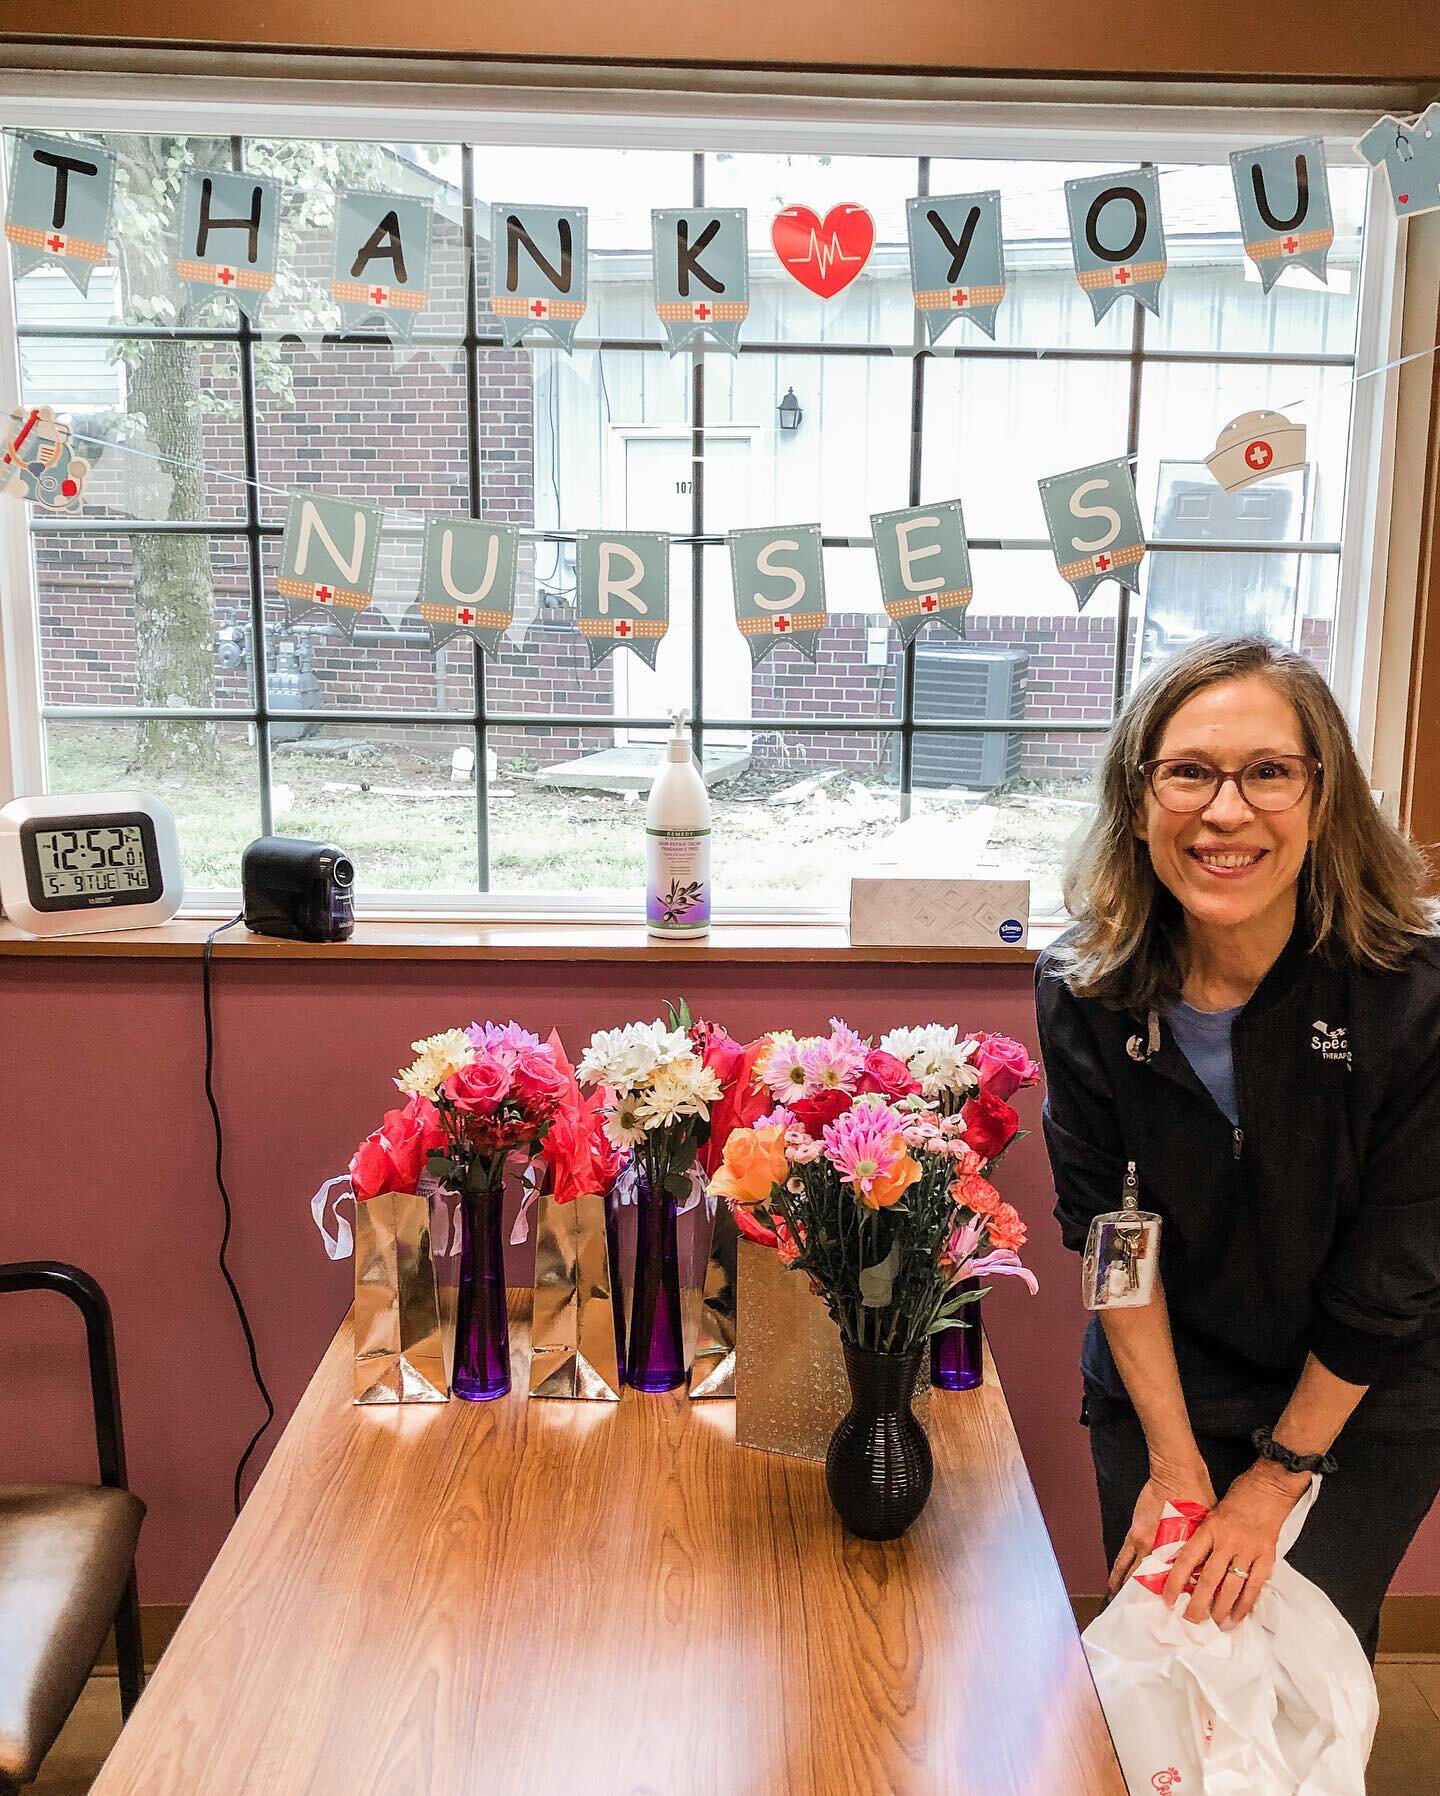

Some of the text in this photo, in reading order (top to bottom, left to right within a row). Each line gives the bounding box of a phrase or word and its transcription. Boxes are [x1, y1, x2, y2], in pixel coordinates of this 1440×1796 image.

[32, 149, 1309, 297] THANK YOU
[676, 481, 692, 494] 107
[293, 478, 1122, 616] NURSES
[52, 829, 124, 869] 12:52
[86, 872, 117, 891] TUE
